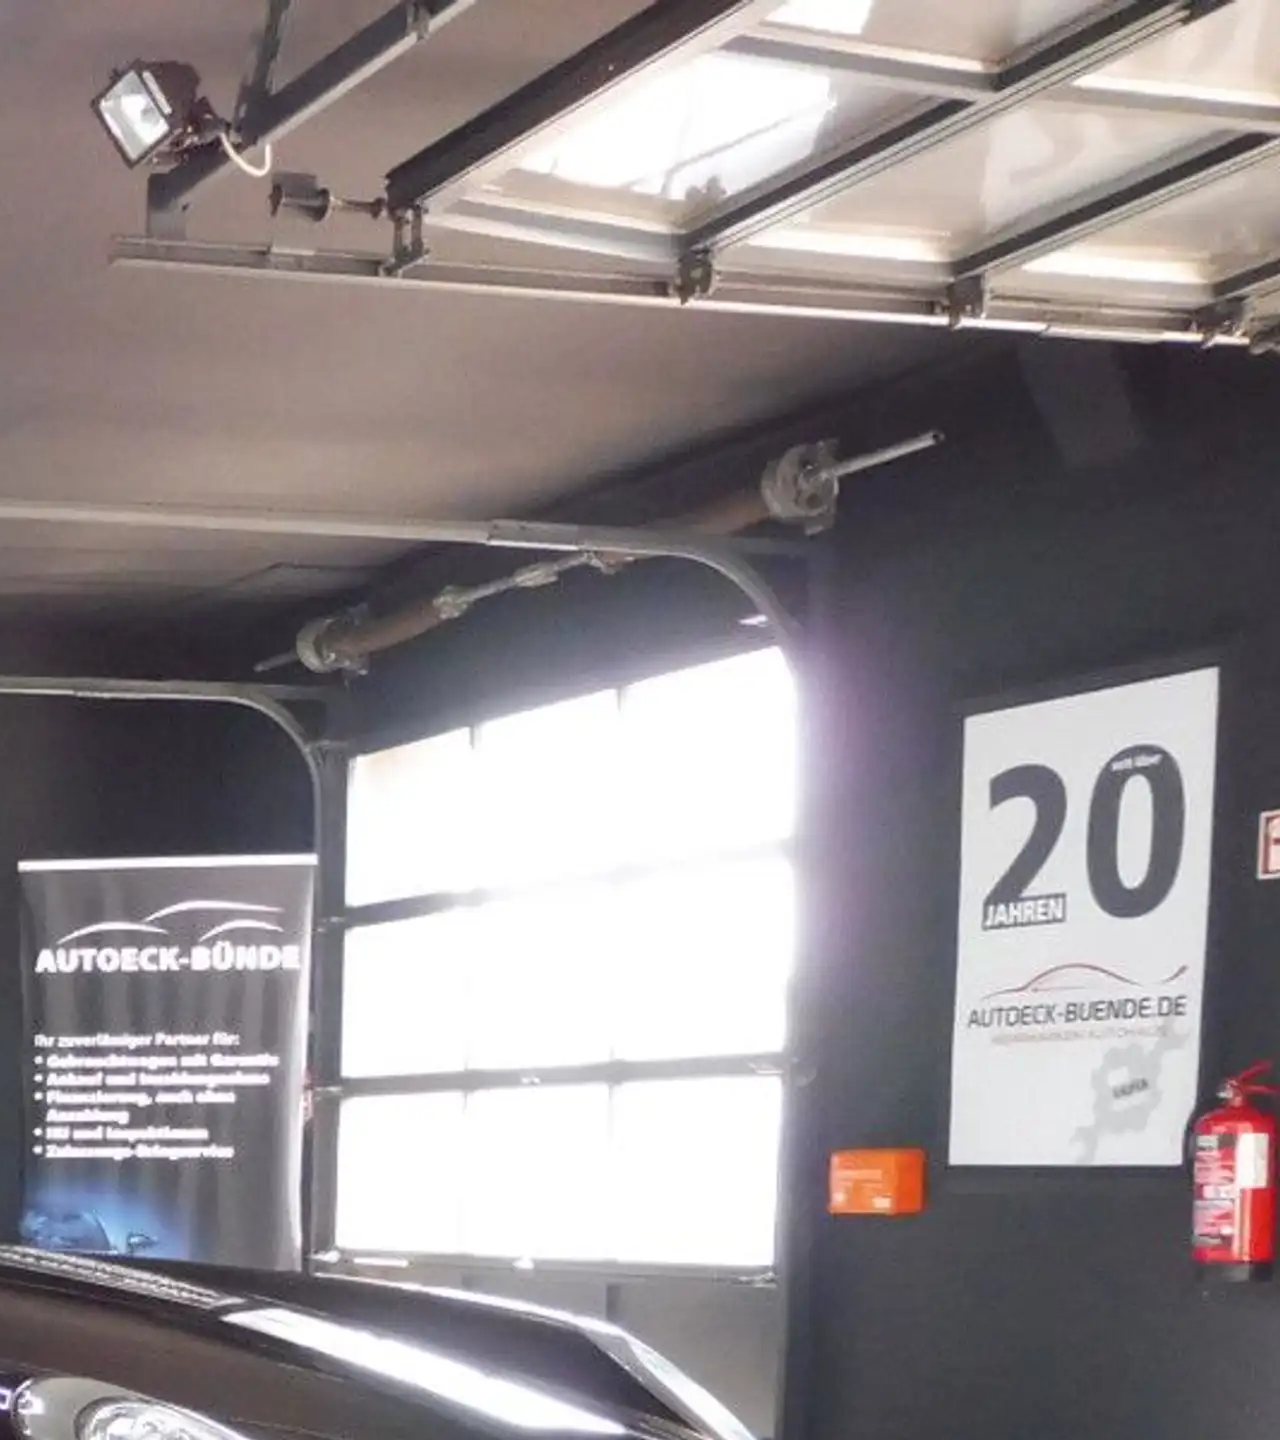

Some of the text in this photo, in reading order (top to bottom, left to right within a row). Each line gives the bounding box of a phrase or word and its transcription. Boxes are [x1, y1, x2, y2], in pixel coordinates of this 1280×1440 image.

[984, 743, 1186, 919] 20
[985, 899, 1063, 926] JAHREN
[35, 941, 301, 973] AUTOECK-BÜNDE
[967, 995, 1187, 1028] AUTOECK-BUENDE.DE
